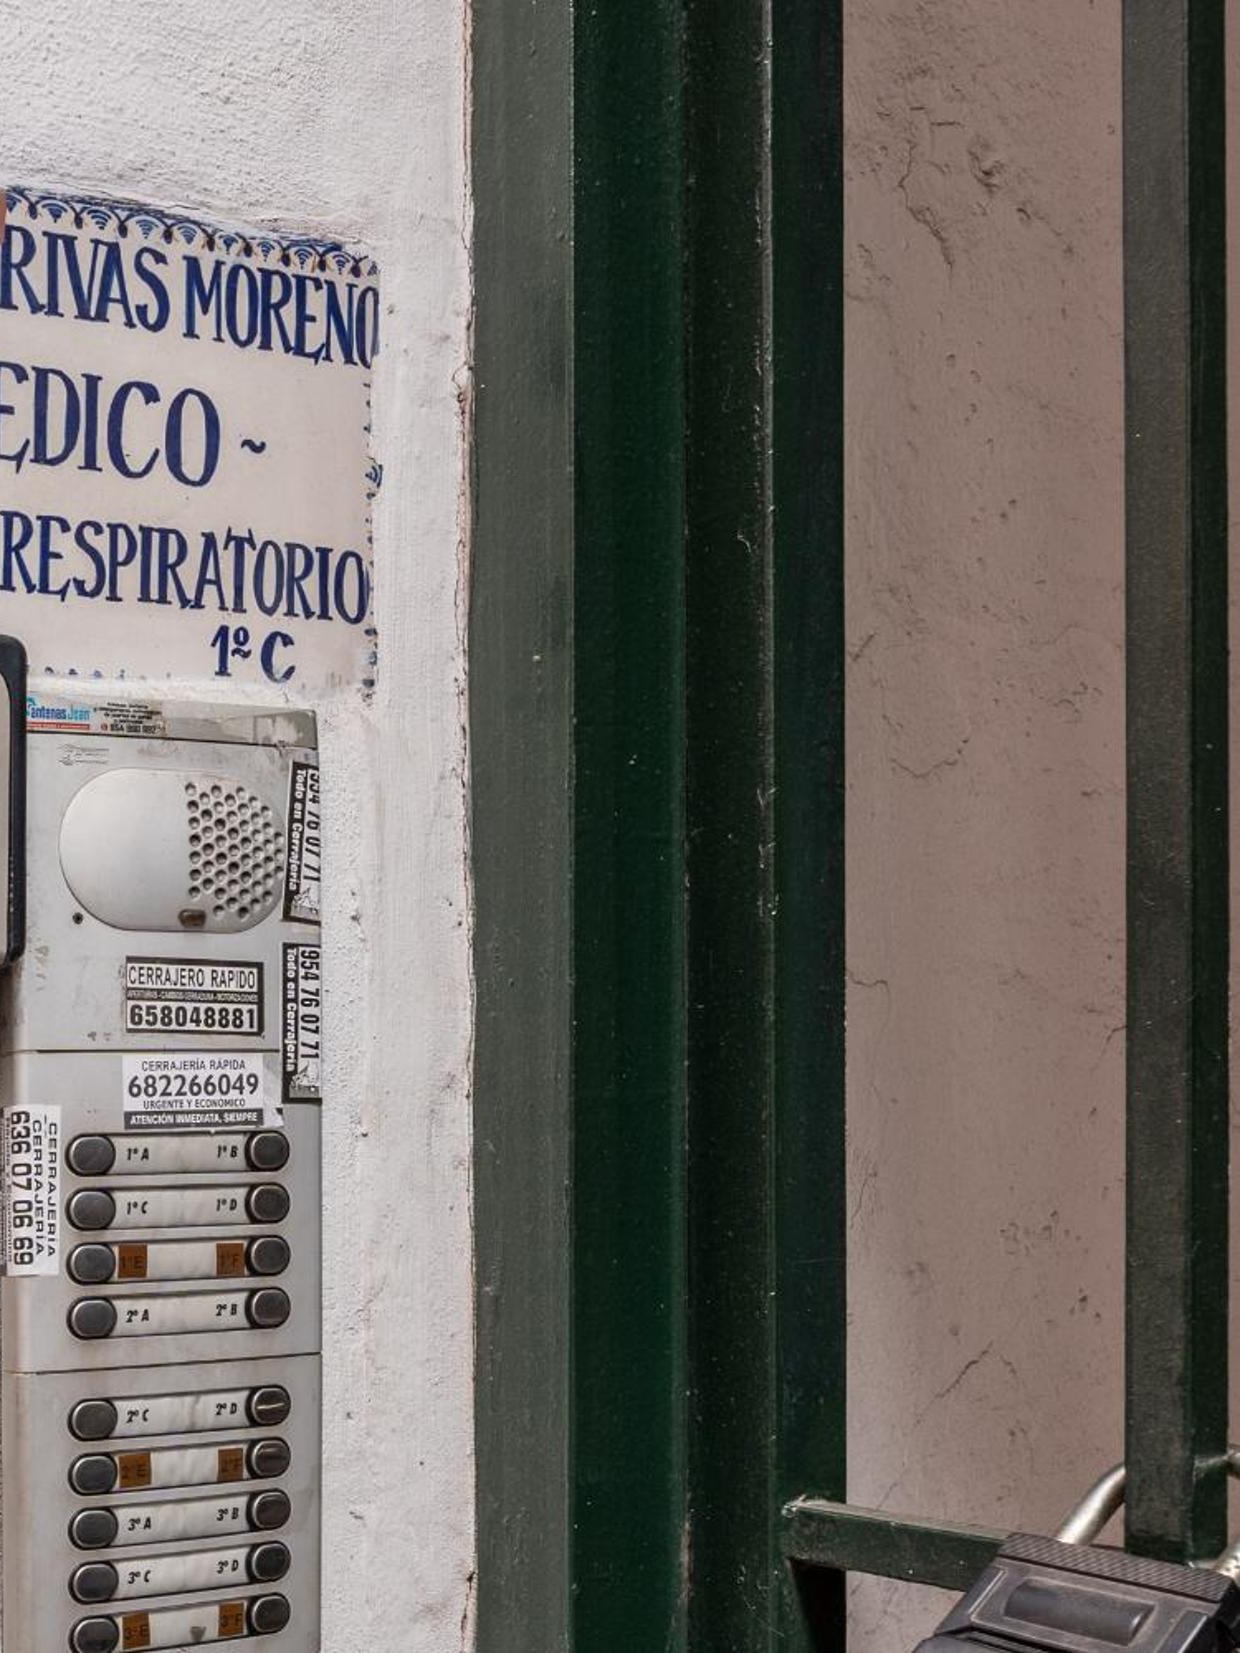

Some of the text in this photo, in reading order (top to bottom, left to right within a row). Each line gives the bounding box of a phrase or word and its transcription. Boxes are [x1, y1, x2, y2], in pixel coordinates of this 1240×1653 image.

[182, 255, 379, 369] MORENO
[210, 624, 296, 683] 1º C
[295, 769, 307, 799] Todo
[293, 802, 303, 819] en
[287, 949, 297, 978] Todo
[128, 966, 255, 989] CERRAJERO RAPIDO
[286, 981, 296, 999] en
[300, 950, 320, 1059] 954 76 07 71
[130, 1004, 255, 1029] 658048881
[141, 1058, 246, 1072] CERRAJERÍA RAPIDA
[128, 1073, 259, 1098] 682266049
[143, 1100, 184, 1110] URGENTE
[187, 1100, 192, 1108] Y
[130, 1112, 174, 1125] ATENCIÓN
[141, 1148, 149, 1161] A
[230, 1145, 238, 1158] B
[11, 1110, 34, 1266] 636 07 06 69
[141, 1201, 148, 1214] C
[230, 1198, 237, 1211] D
[141, 1309, 149, 1322] A
[230, 1303, 237, 1316] B
[230, 1402, 237, 1415] D
[142, 1409, 149, 1422] C
[231, 1507, 239, 1520] B
[144, 1516, 152, 1530] A
[231, 1559, 239, 1572] D
[144, 1570, 151, 1583] C
